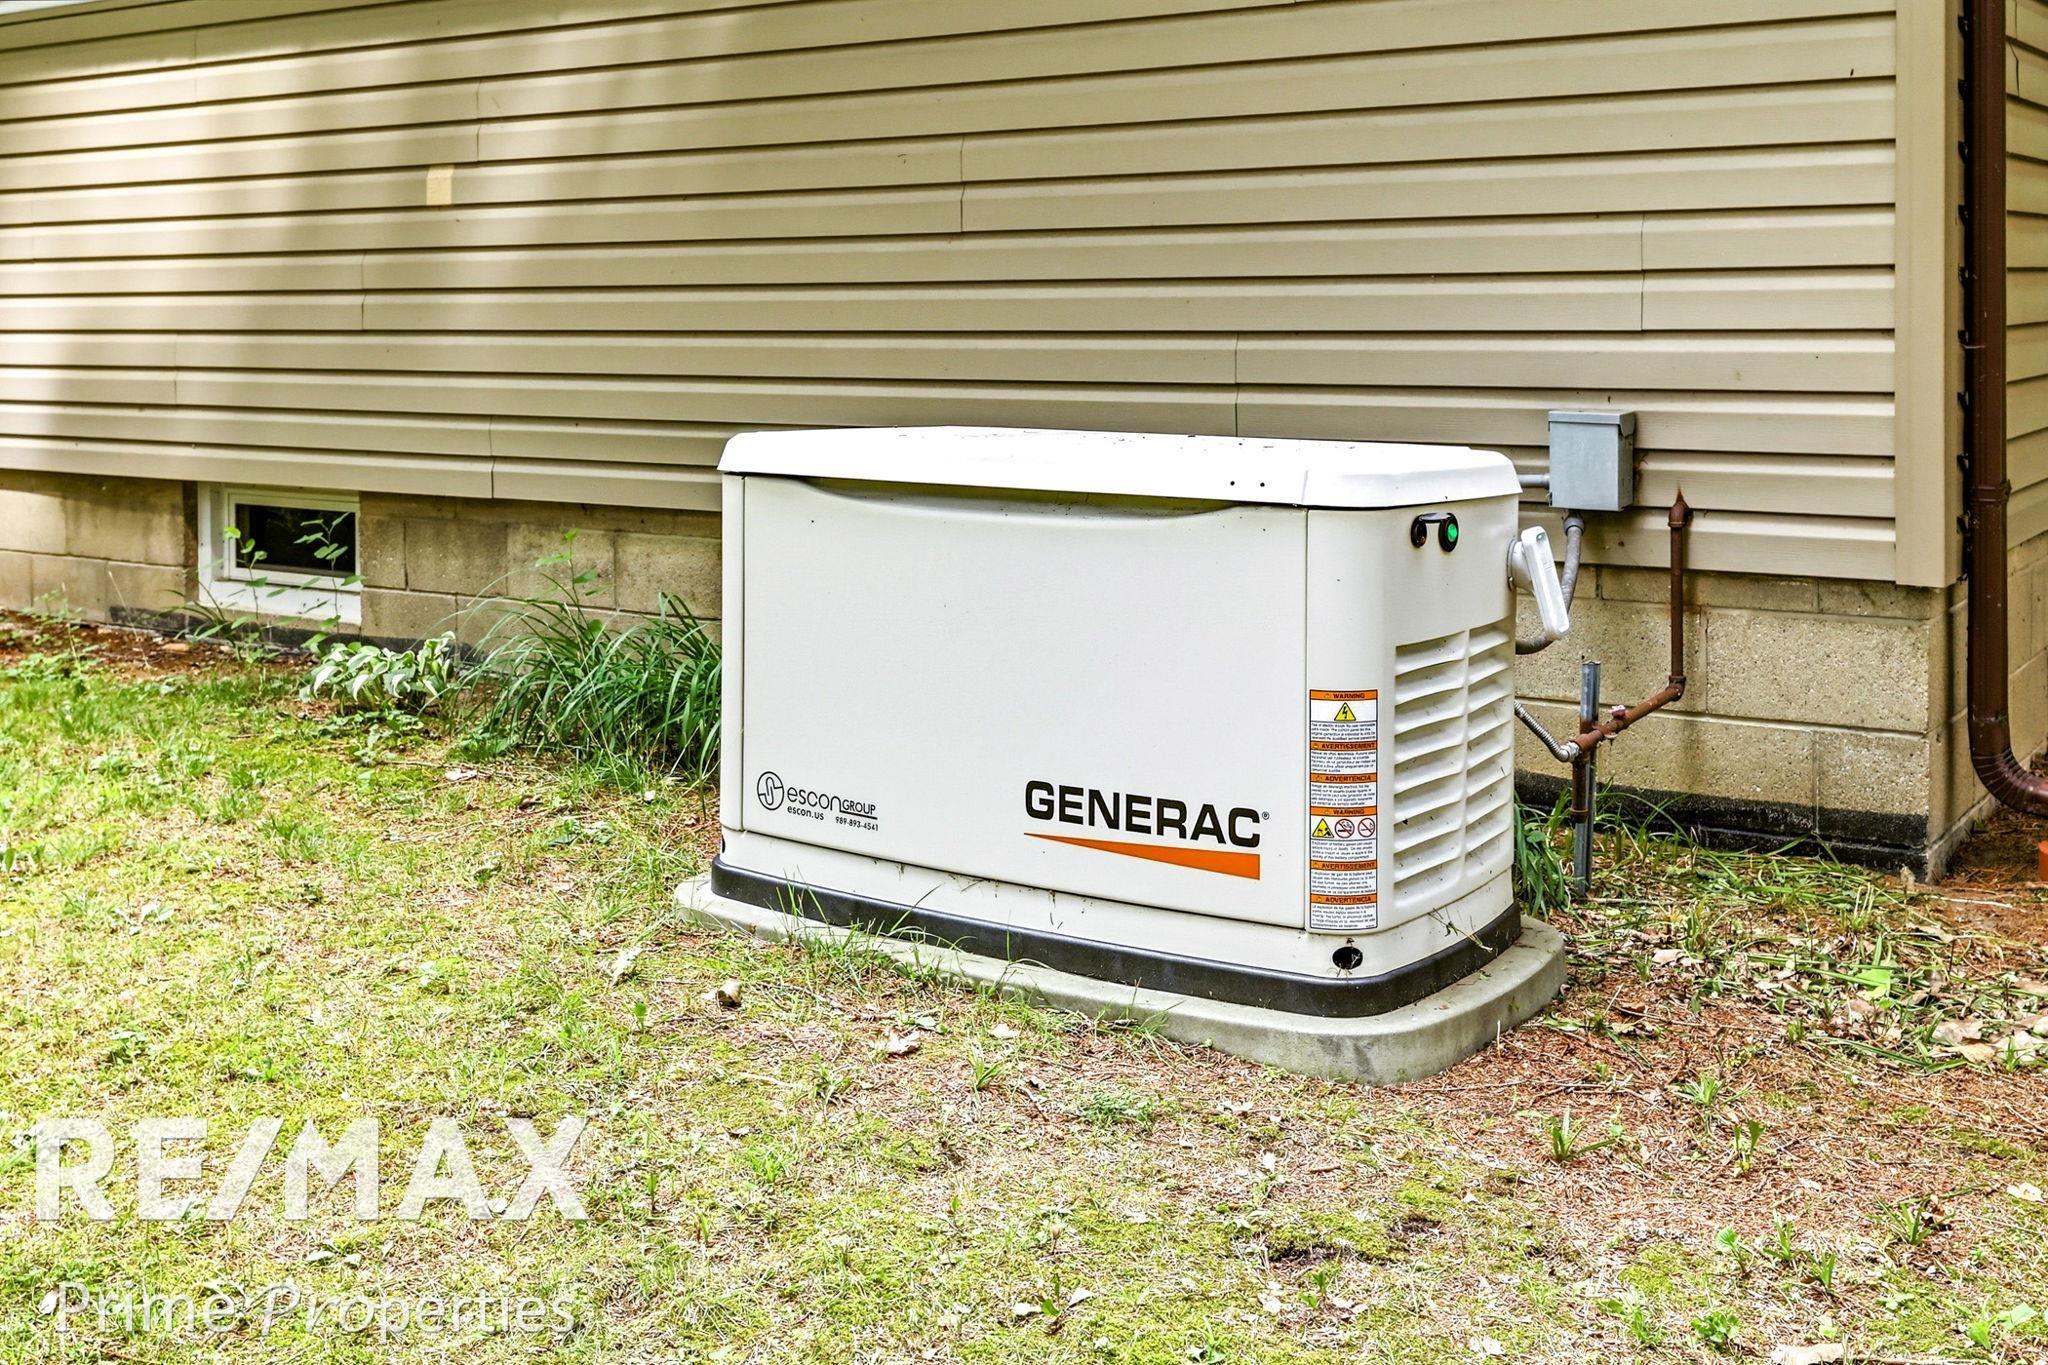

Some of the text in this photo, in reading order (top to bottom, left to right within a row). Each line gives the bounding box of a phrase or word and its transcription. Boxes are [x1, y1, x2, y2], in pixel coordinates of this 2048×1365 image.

[1333, 692, 1365, 700] WARNING
[1321, 742, 1375, 751] AVERTISSEMENT
[1325, 775, 1371, 783] ADVERTENCIA
[787, 805, 824, 821] escon.us
[1333, 808, 1365, 816] WARNING
[835, 816, 879, 832] 989-893-4541
[1321, 862, 1375, 870] AVERTISSEMENT
[1325, 896, 1371, 904] ADVERTENCIA
